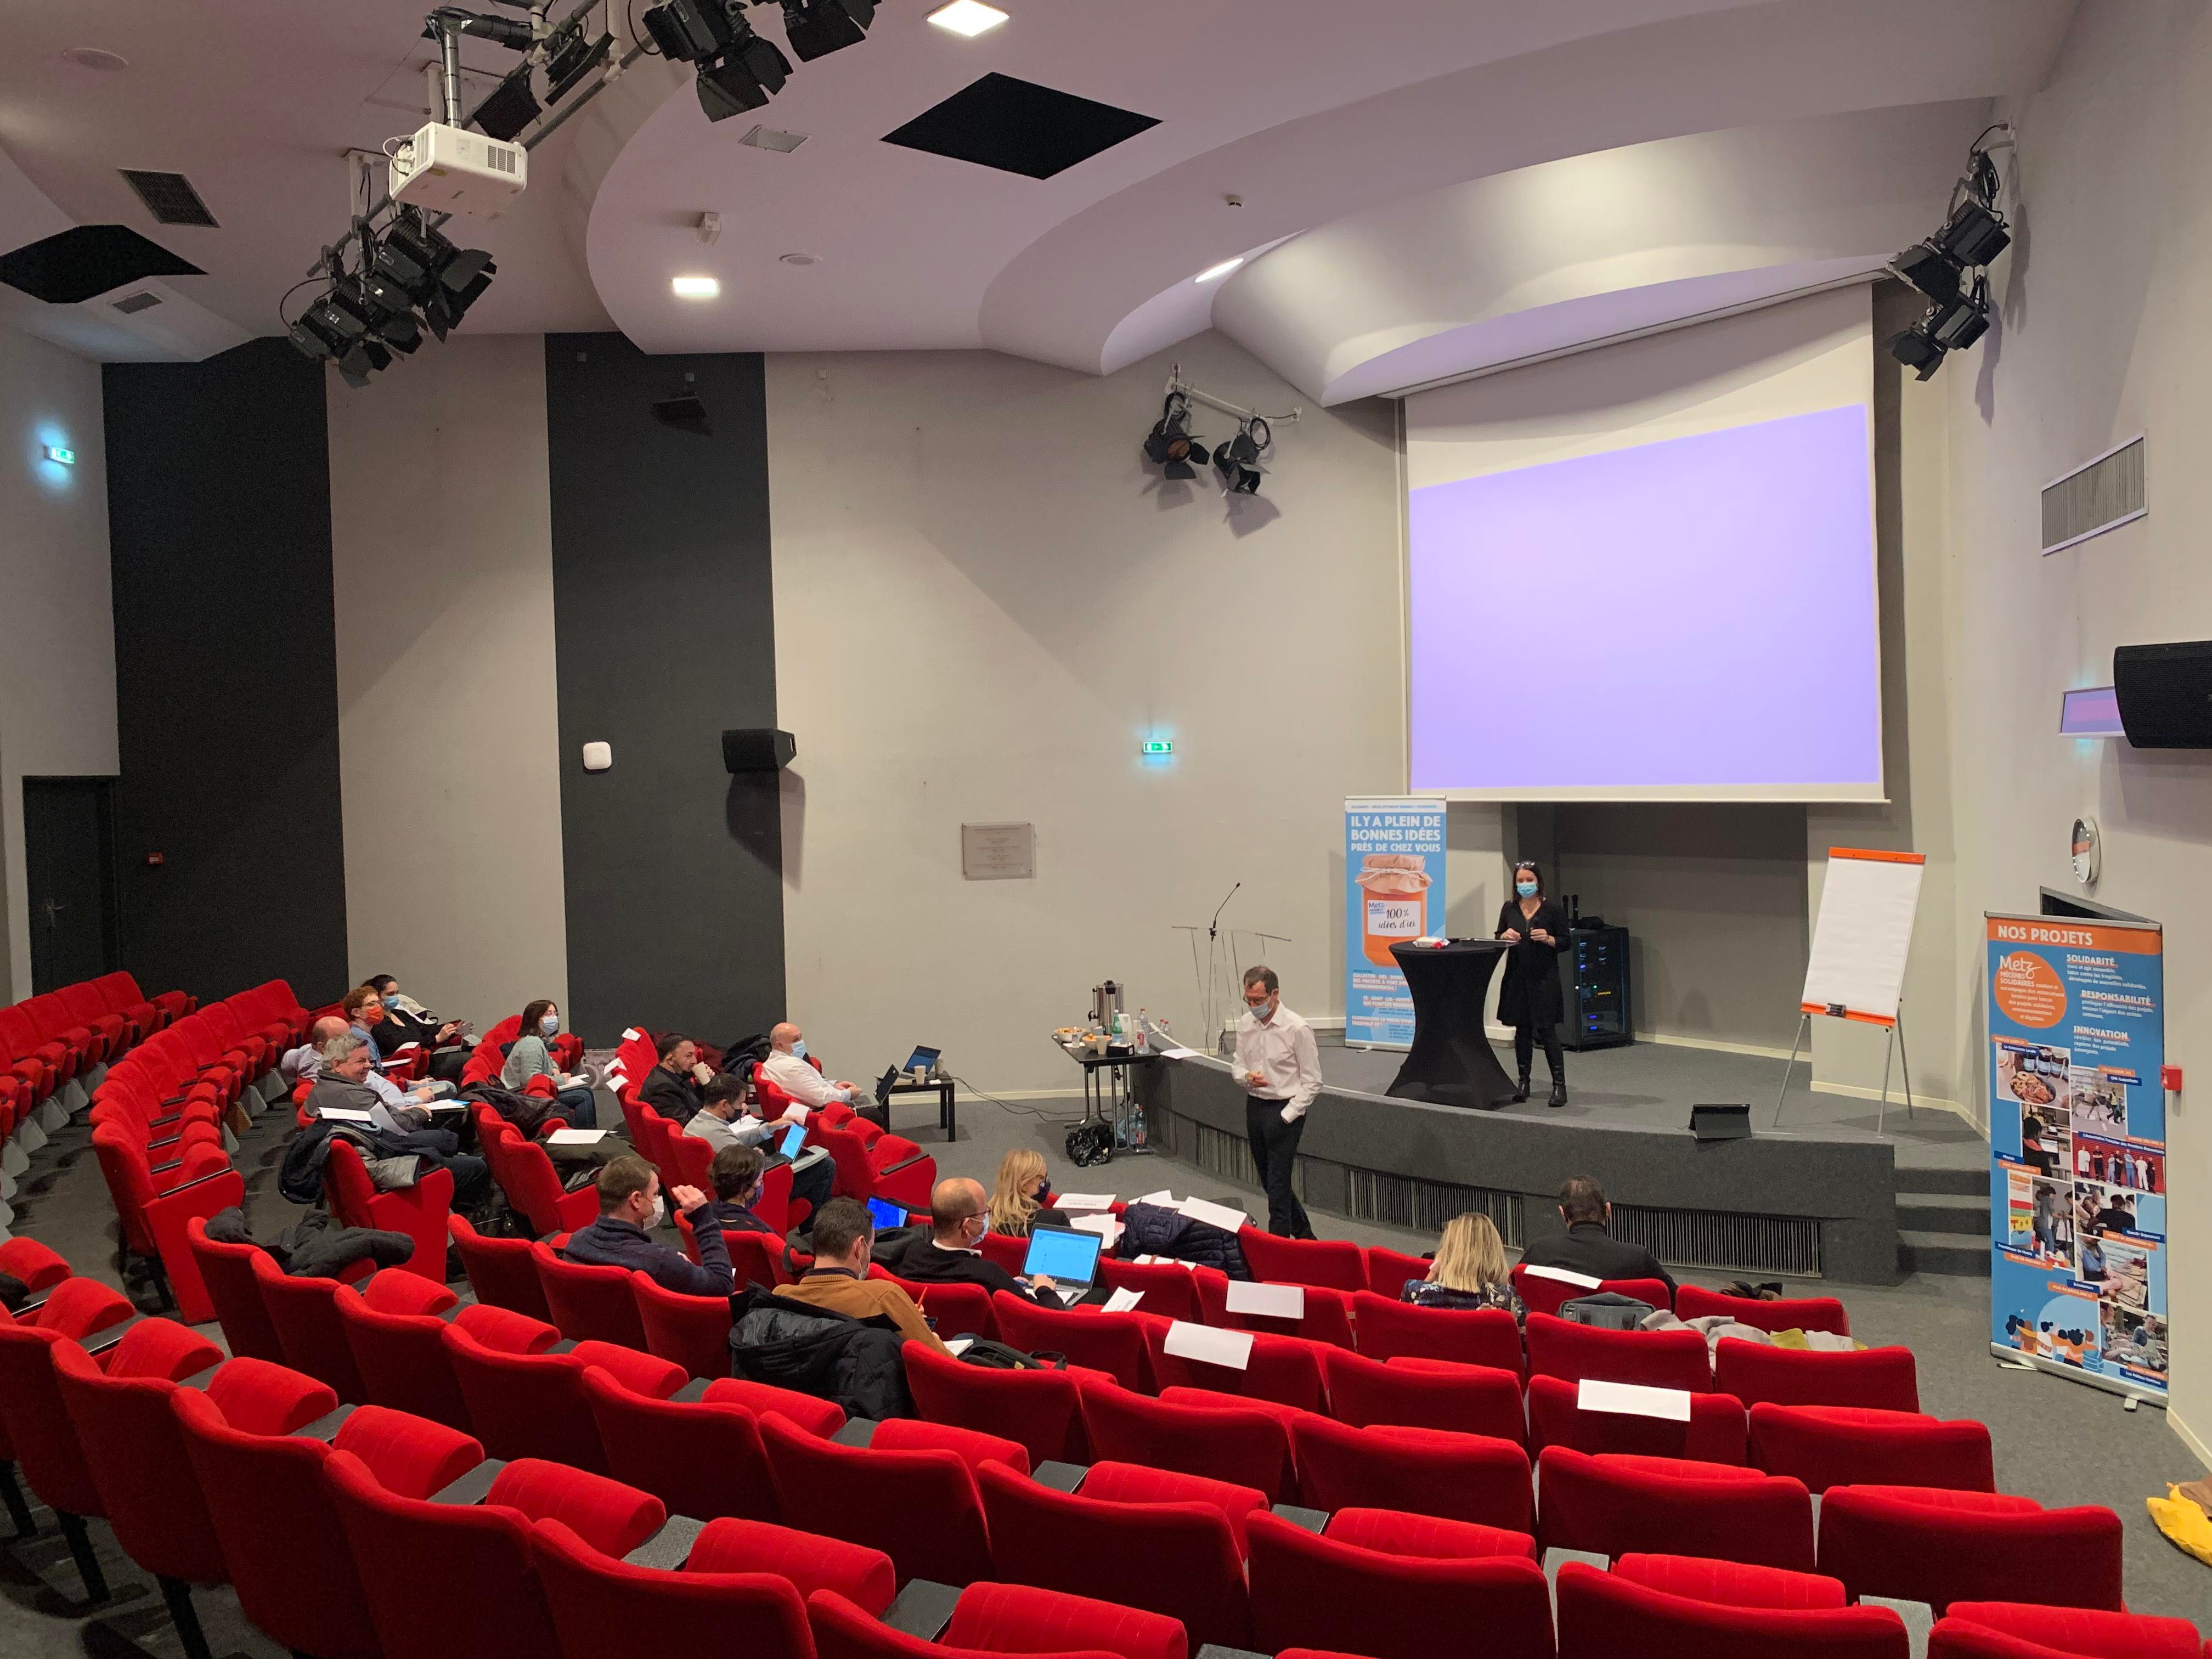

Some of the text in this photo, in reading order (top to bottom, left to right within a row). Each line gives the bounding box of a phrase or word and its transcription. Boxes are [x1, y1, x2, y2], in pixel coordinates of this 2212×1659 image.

[1351, 816, 1441, 827] IL Y A PLEIN DE
[1351, 827, 1441, 840] BONNES IDÉES
[1351, 842, 1373, 851] PRÈS
[1390, 844, 1413, 852] CHEZ
[1415, 844, 1441, 852] VOUS
[1400, 919, 1415, 928] d'ici
[1998, 926, 2093, 946] NOS PROJETS
[2067, 954, 2115, 966] SOLIDARITÉ
[2000, 955, 2041, 980] Metz
[2000, 978, 2035, 987] SOLIDAIRES
[2081, 990, 2151, 1006] RESPONSABILITÉ
[2074, 1025, 2128, 1040] INNOVATION
